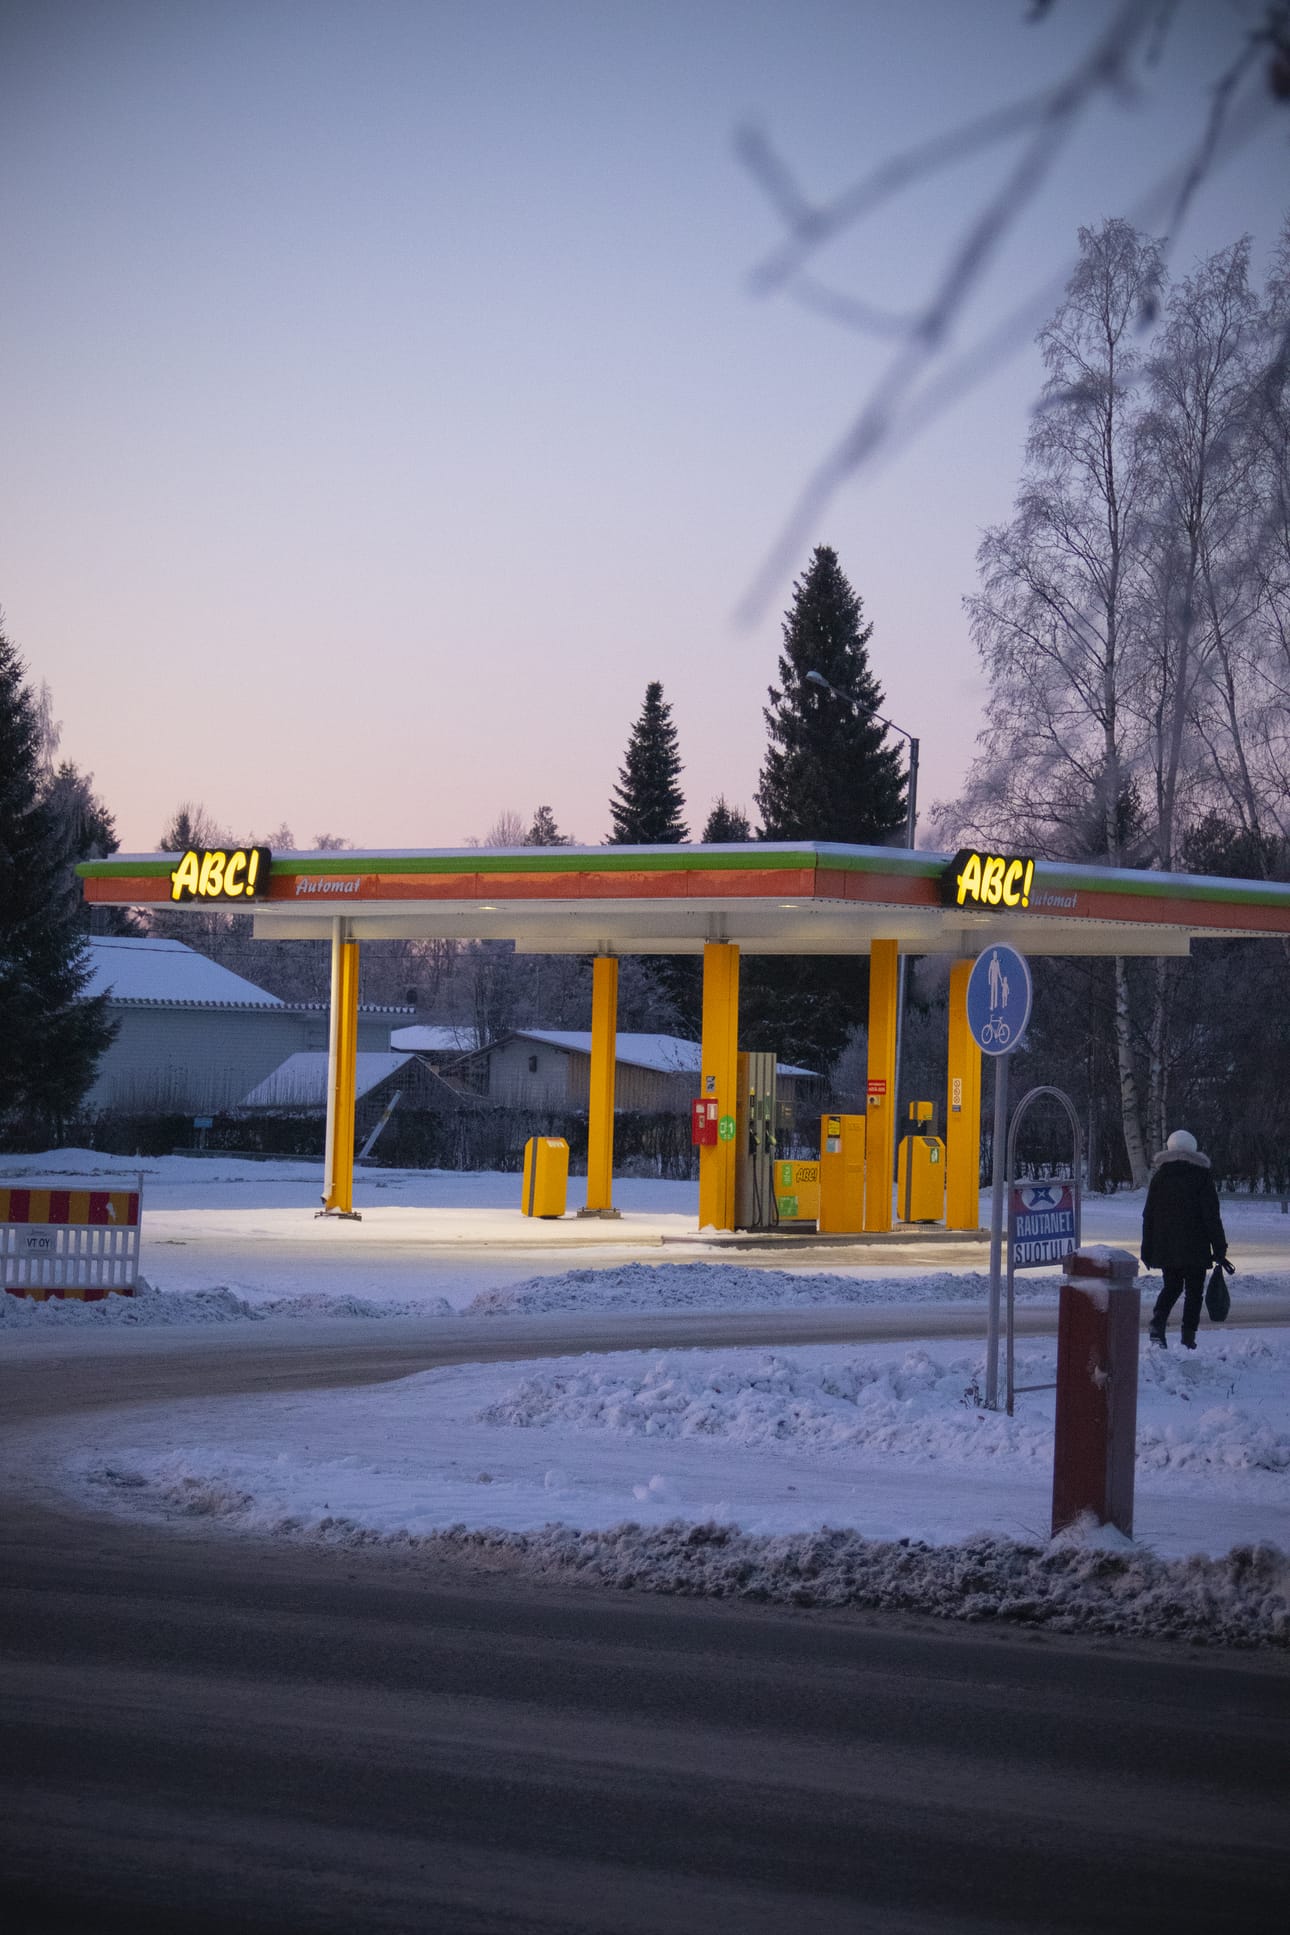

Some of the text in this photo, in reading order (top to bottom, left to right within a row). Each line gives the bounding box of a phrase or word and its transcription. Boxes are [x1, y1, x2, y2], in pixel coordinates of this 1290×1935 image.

[171, 849, 260, 901] ABC!
[296, 876, 362, 896] Automat
[956, 853, 1034, 908] ABC!
[1016, 1210, 1073, 1237] RAUTANET
